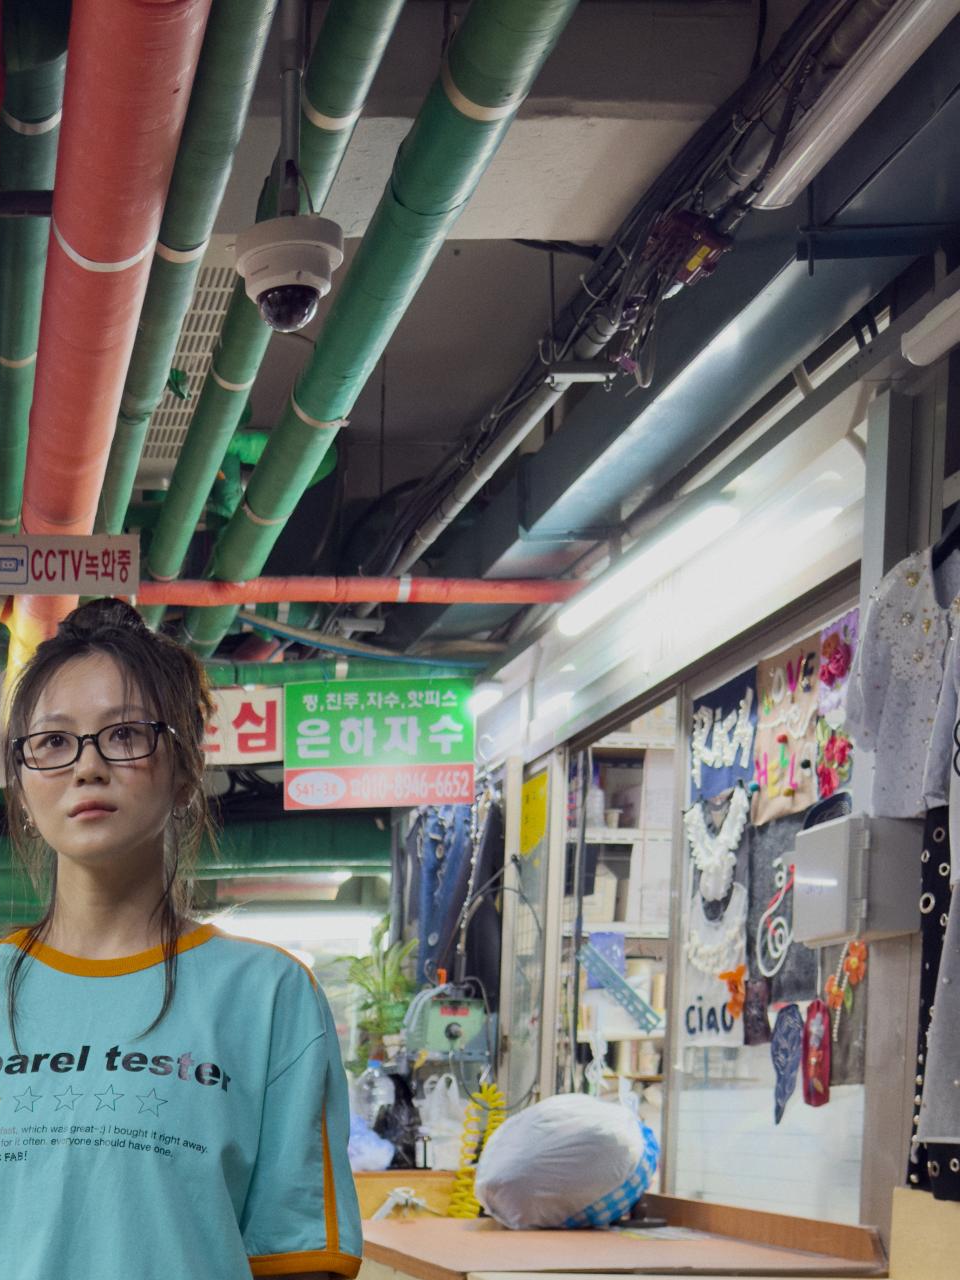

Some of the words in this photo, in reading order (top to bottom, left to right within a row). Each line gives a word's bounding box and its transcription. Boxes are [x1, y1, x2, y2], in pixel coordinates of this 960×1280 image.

[31, 549, 131, 583] CCTV녹화중
[200, 700, 277, 754] 심
[296, 714, 464, 759] 은하자수
[105, 1044, 232, 1092] tester
[0, 1137, 13, 1148] for
[94, 1137, 127, 1148] should
[128, 1140, 152, 1152] have
[4, 1150, 28, 1162] FAB!
[21, 1124, 48, 1134] which
[113, 1125, 148, 1139] bought
[150, 1128, 157, 1140] it
[159, 1132, 181, 1146] right
[183, 1139, 209, 1154] away.
